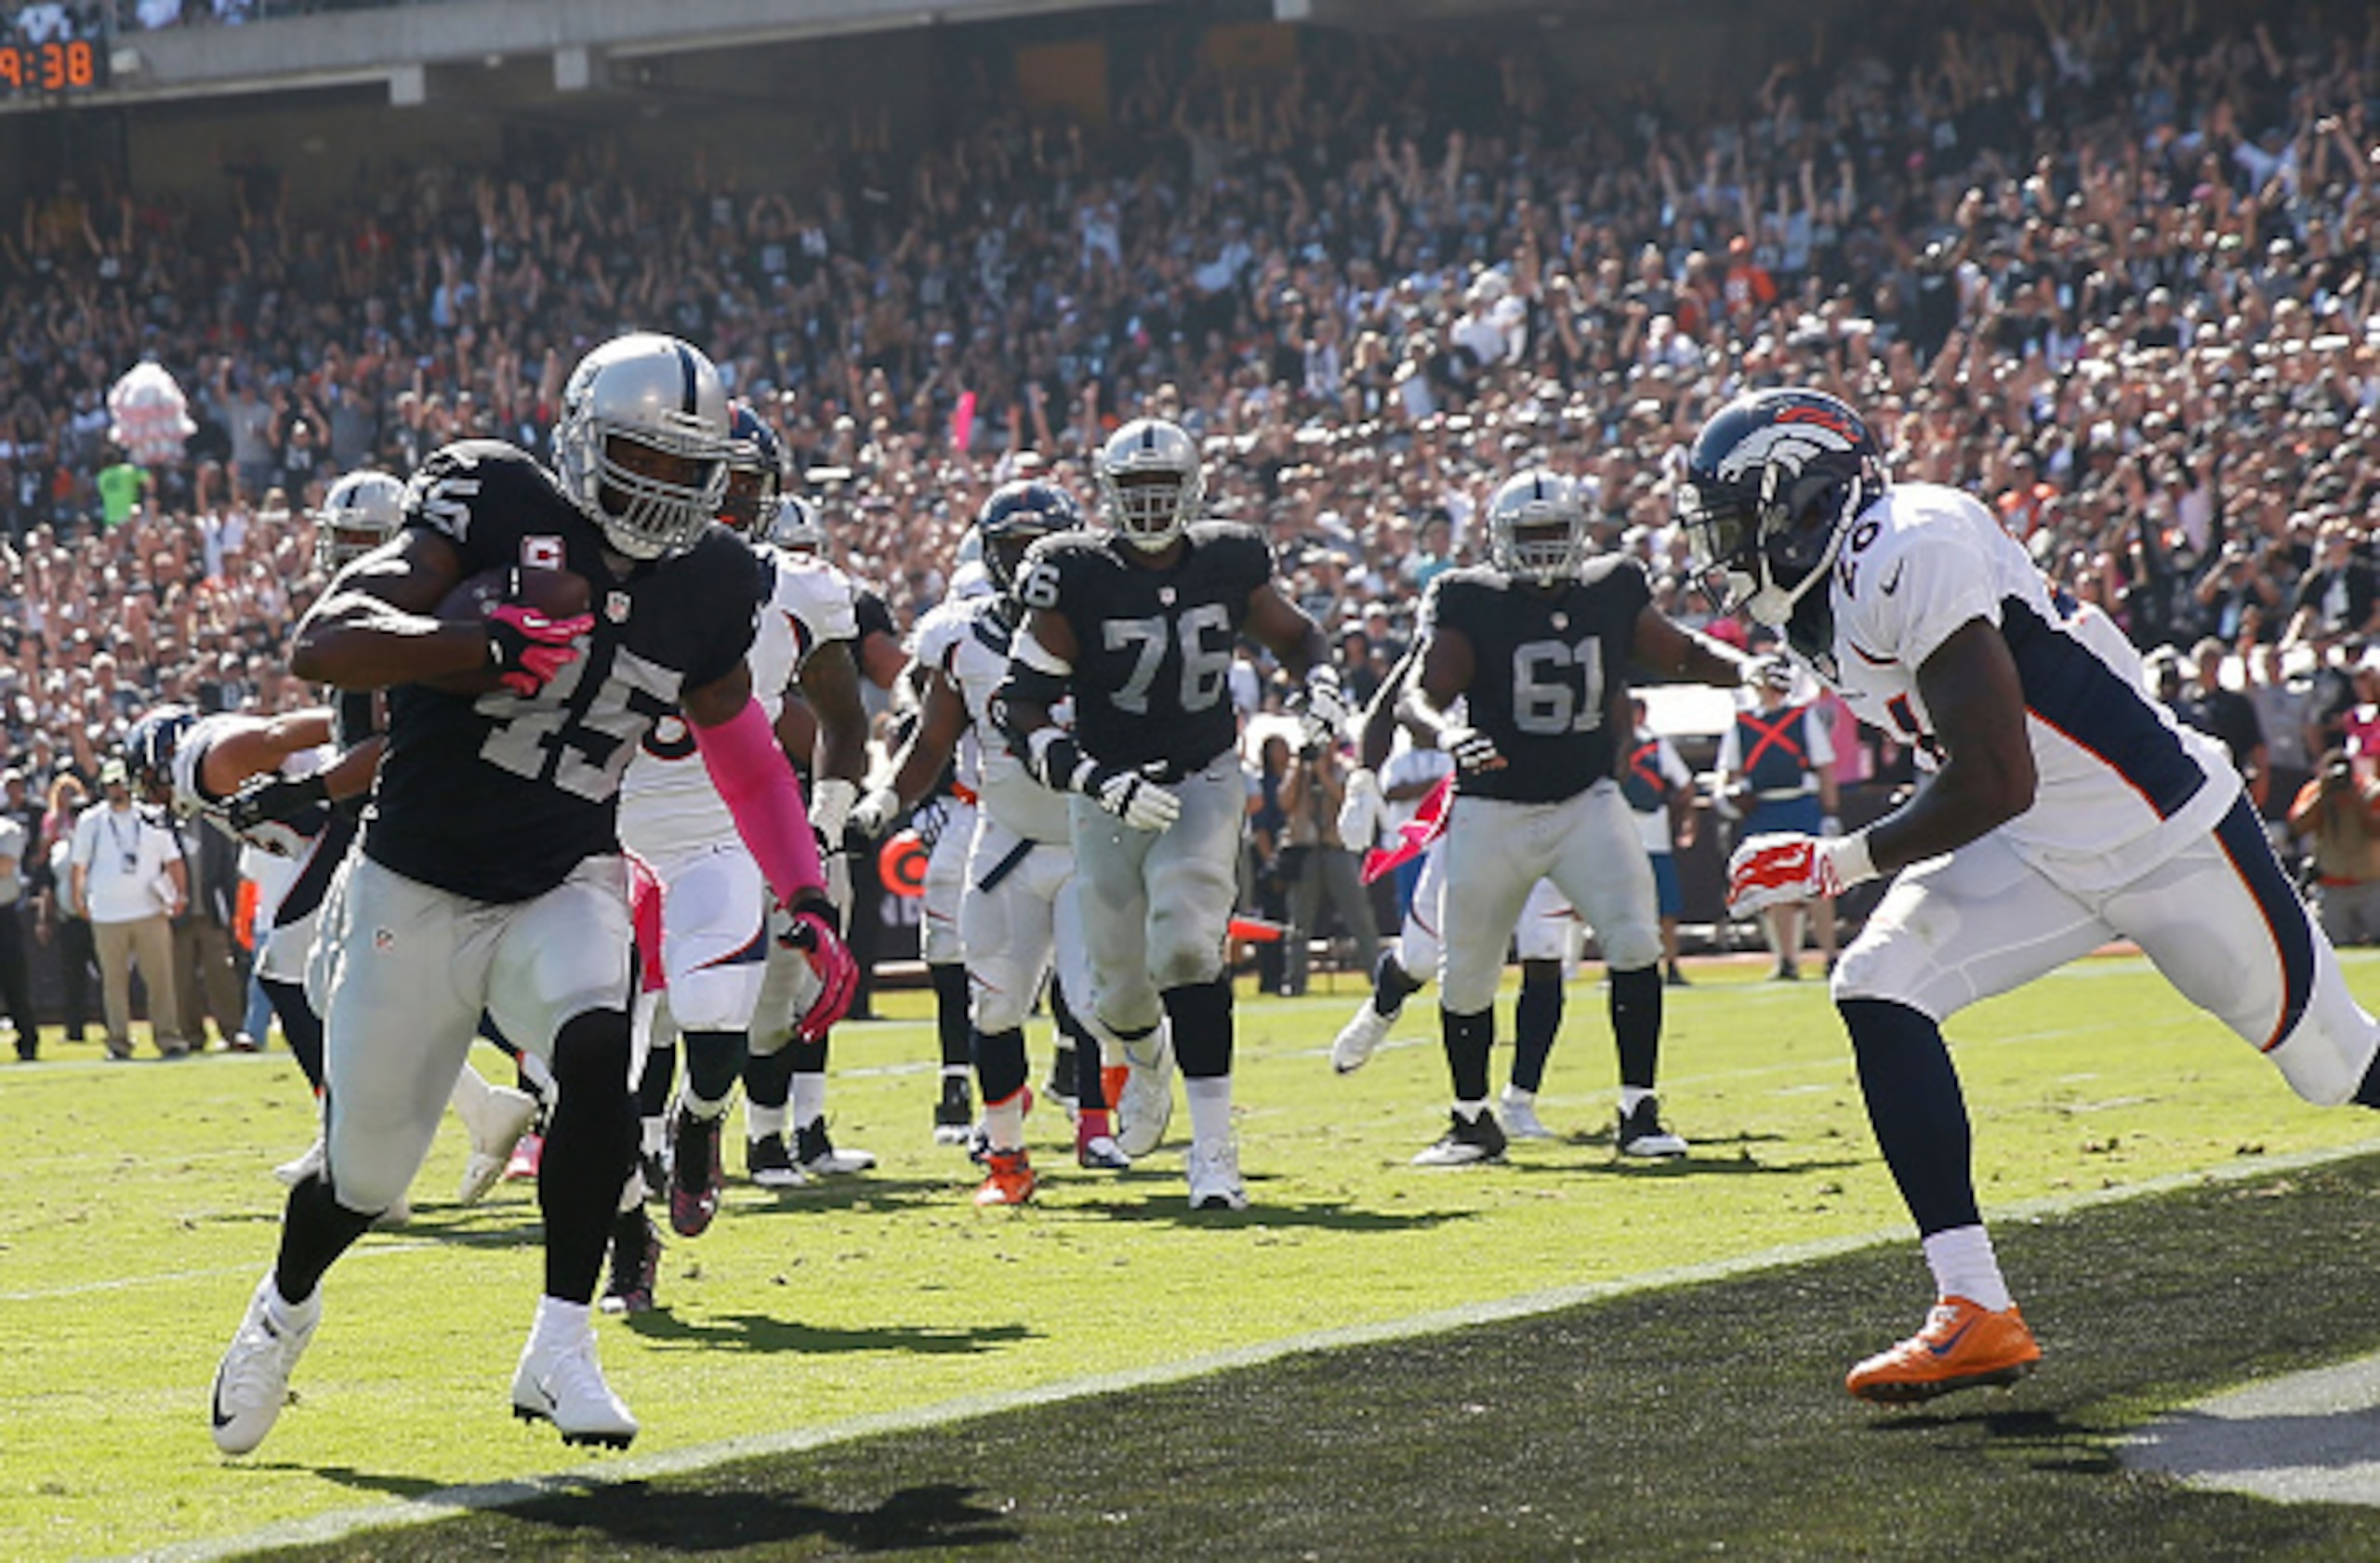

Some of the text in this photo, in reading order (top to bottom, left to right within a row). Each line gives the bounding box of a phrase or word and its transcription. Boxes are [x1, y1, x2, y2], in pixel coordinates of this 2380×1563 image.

[0, 41, 92, 90] 9:38
[1103, 604, 1231, 714] 76
[1513, 636, 1604, 734] 61
[475, 635, 684, 803] 45
